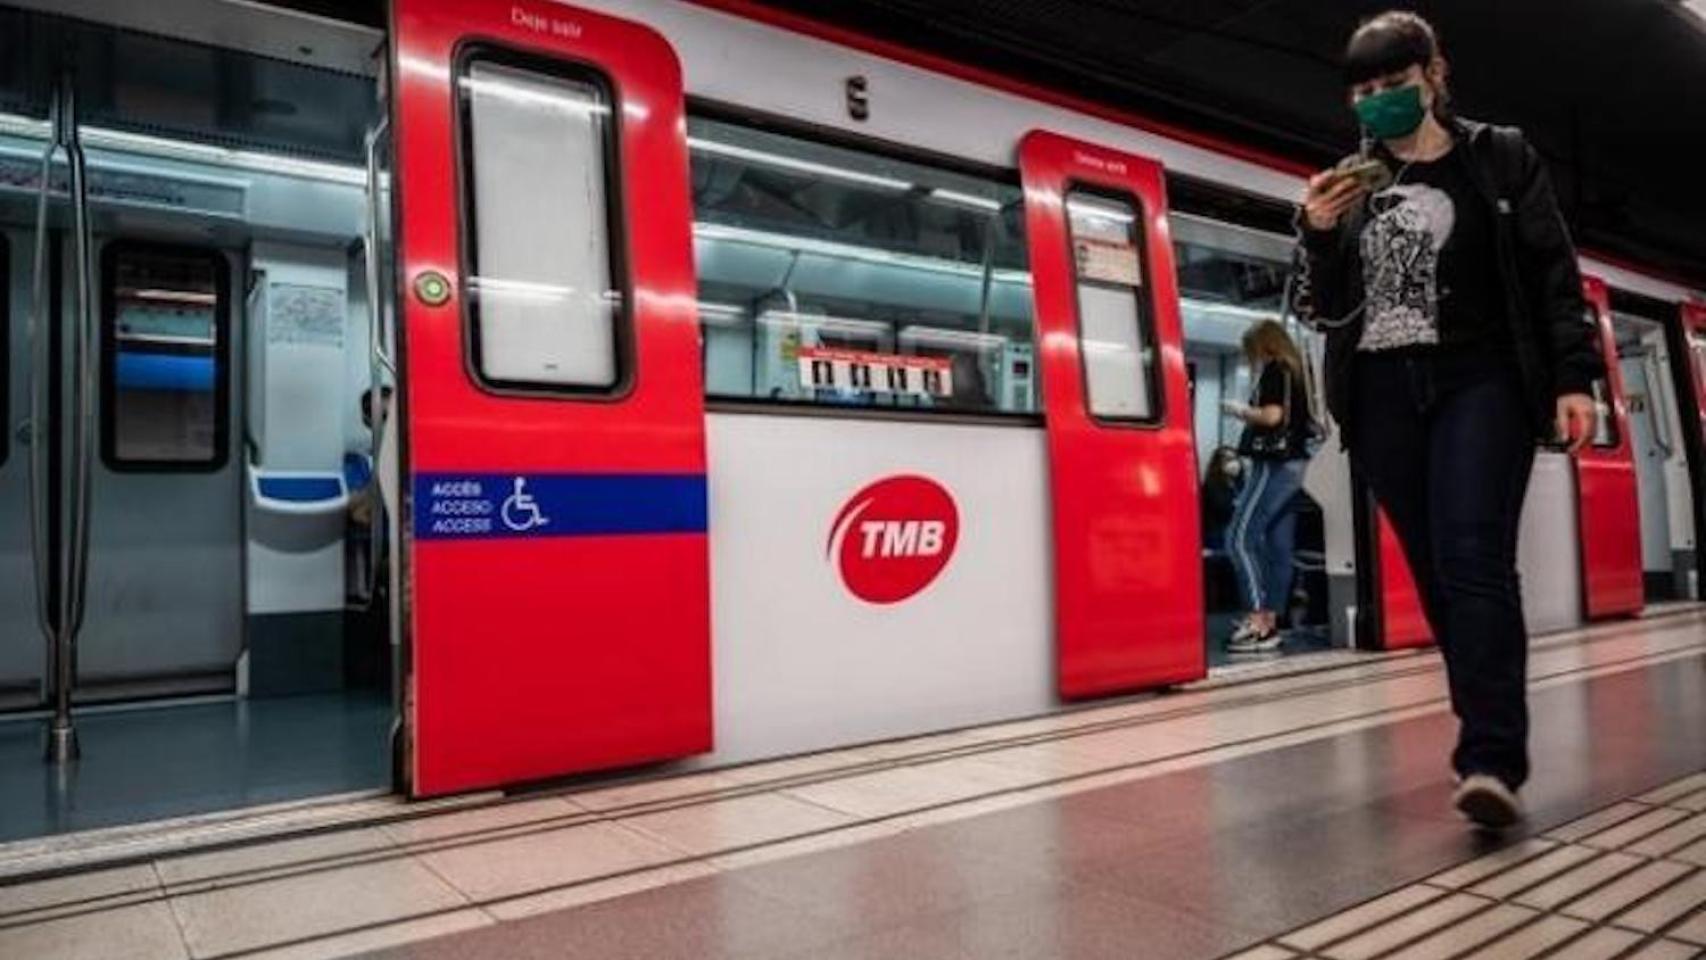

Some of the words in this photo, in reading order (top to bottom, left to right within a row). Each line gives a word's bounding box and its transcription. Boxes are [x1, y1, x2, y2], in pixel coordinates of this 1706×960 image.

[432, 500, 493, 515] ACCESO
[433, 518, 492, 533] ACCESS
[860, 520, 946, 559] TMB
